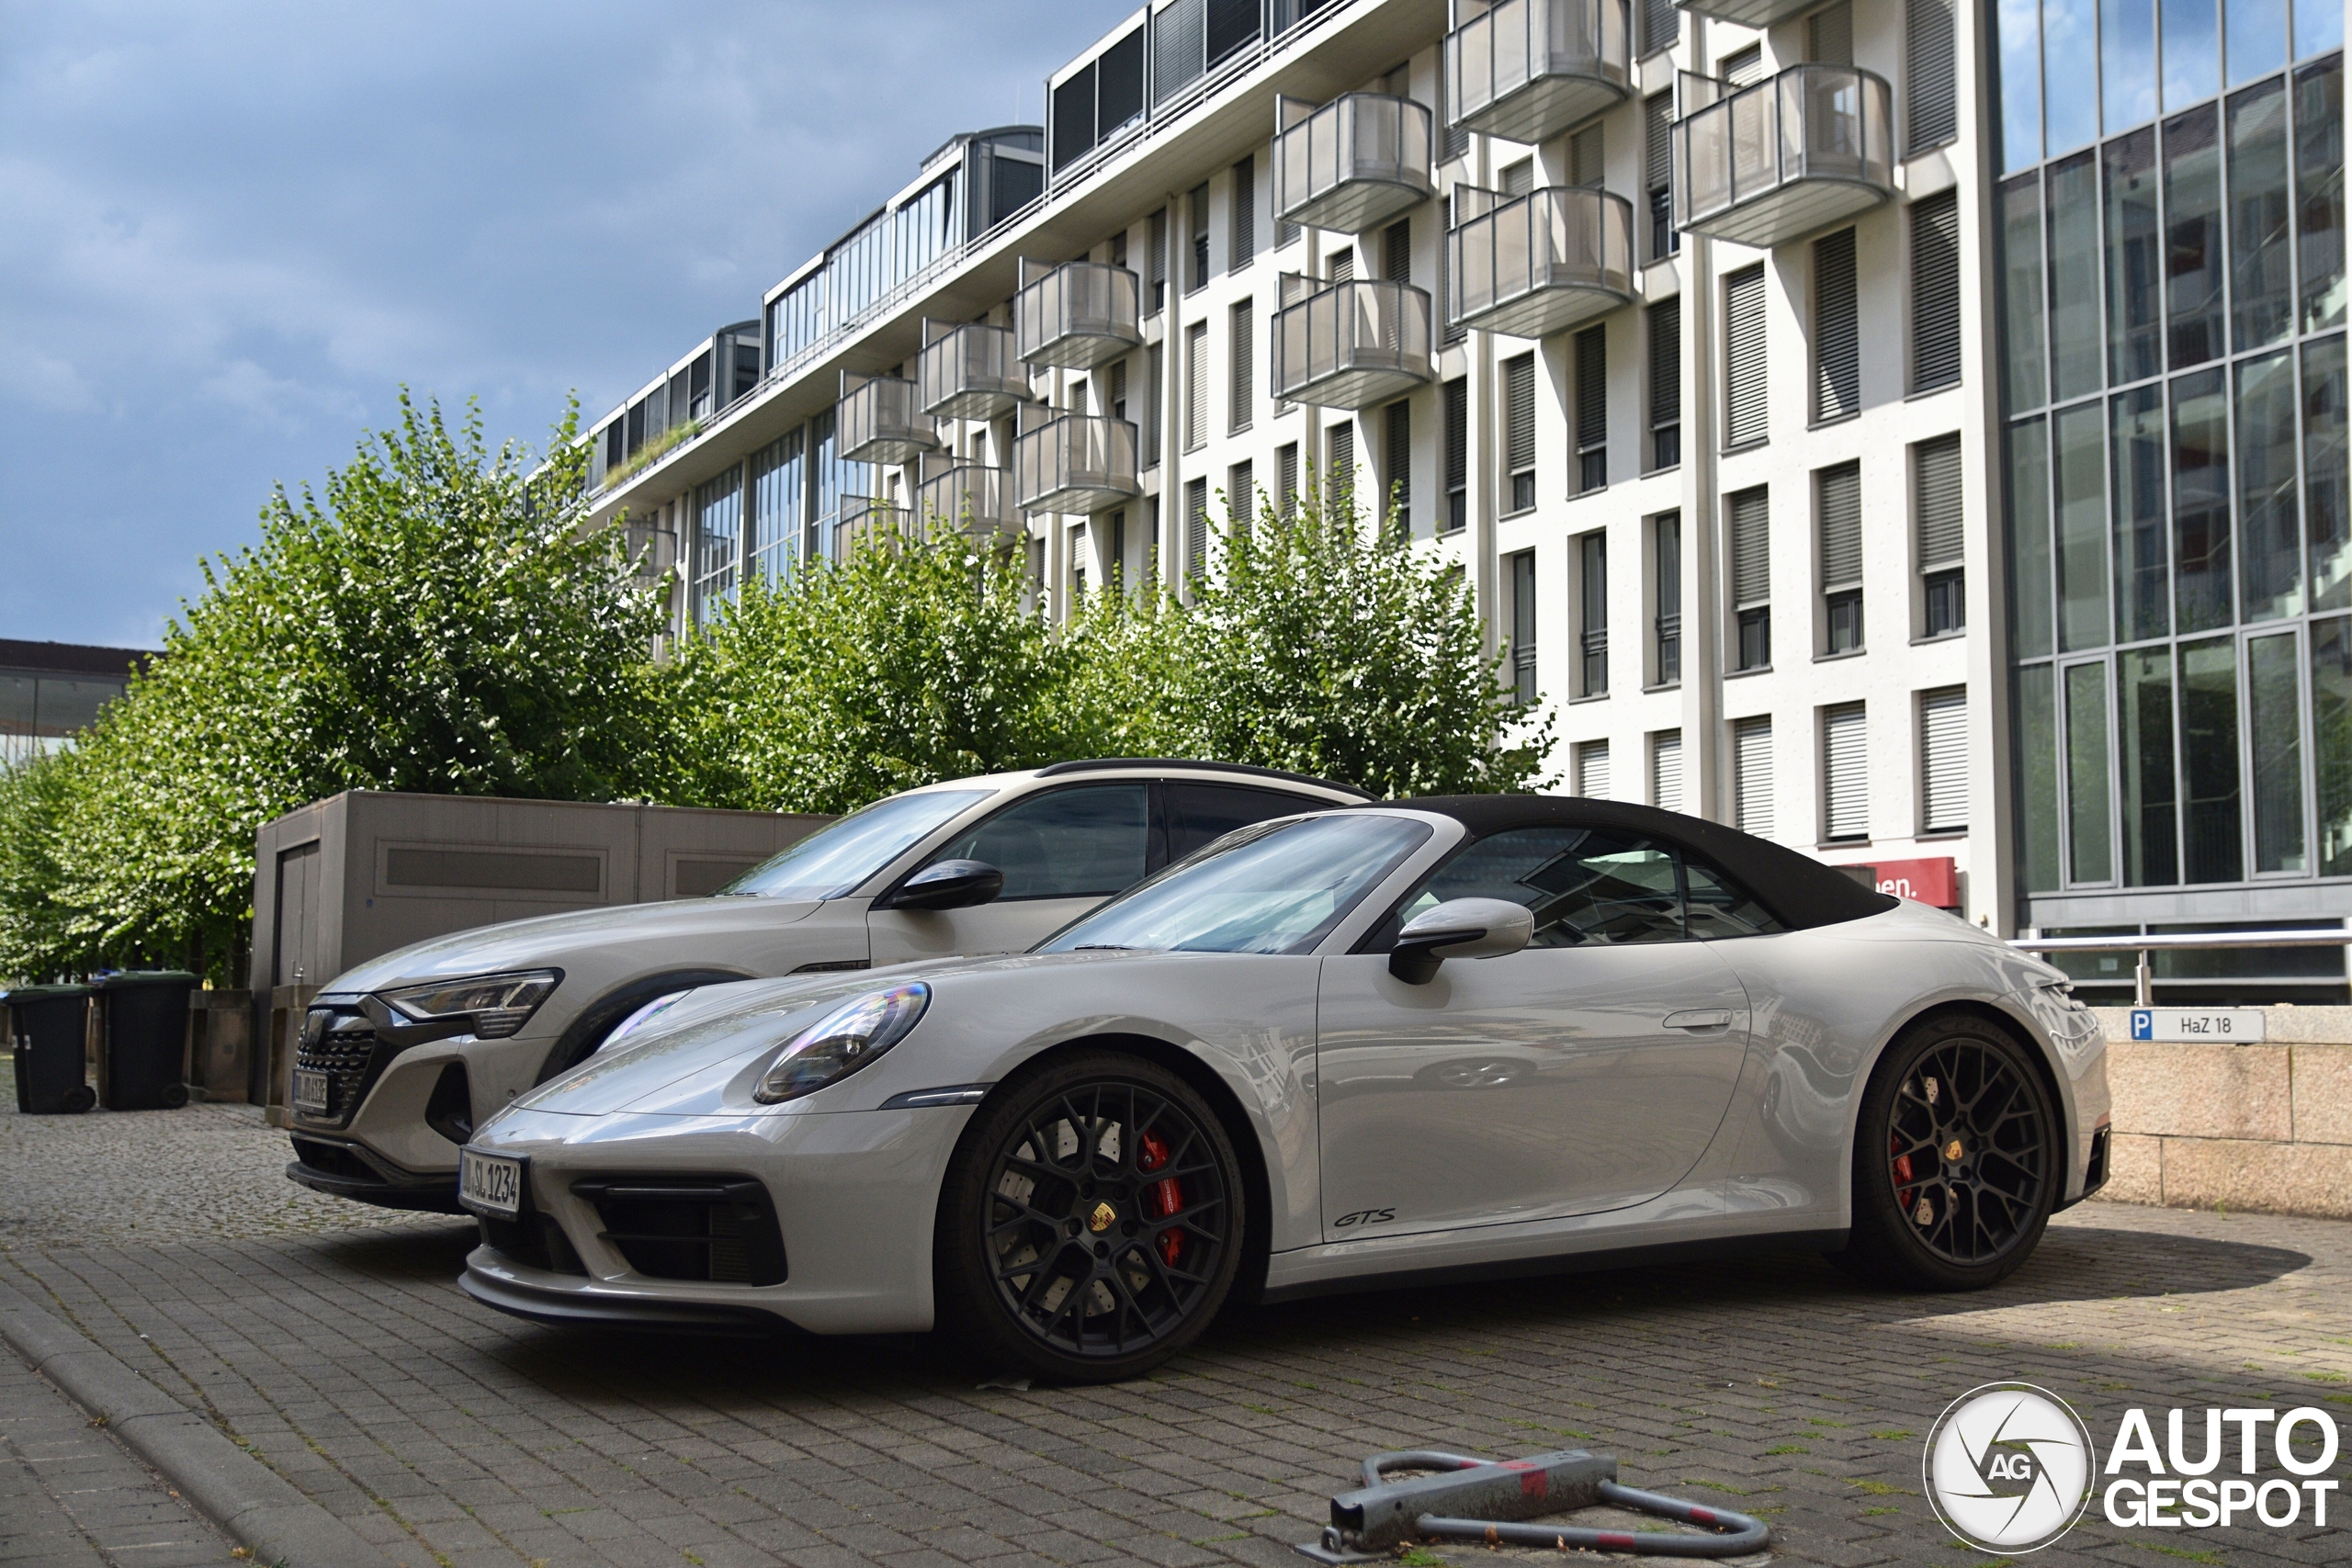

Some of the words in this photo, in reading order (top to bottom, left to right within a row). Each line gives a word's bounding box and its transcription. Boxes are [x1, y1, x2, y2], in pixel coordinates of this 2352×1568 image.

[2134, 1013, 2149, 1037] P
[2181, 1017, 2210, 1033] HaZ
[2216, 1017, 2232, 1033] 18
[475, 1159, 486, 1199] SL
[488, 1162, 517, 1205] 1234
[1334, 1208, 1396, 1227] GTS
